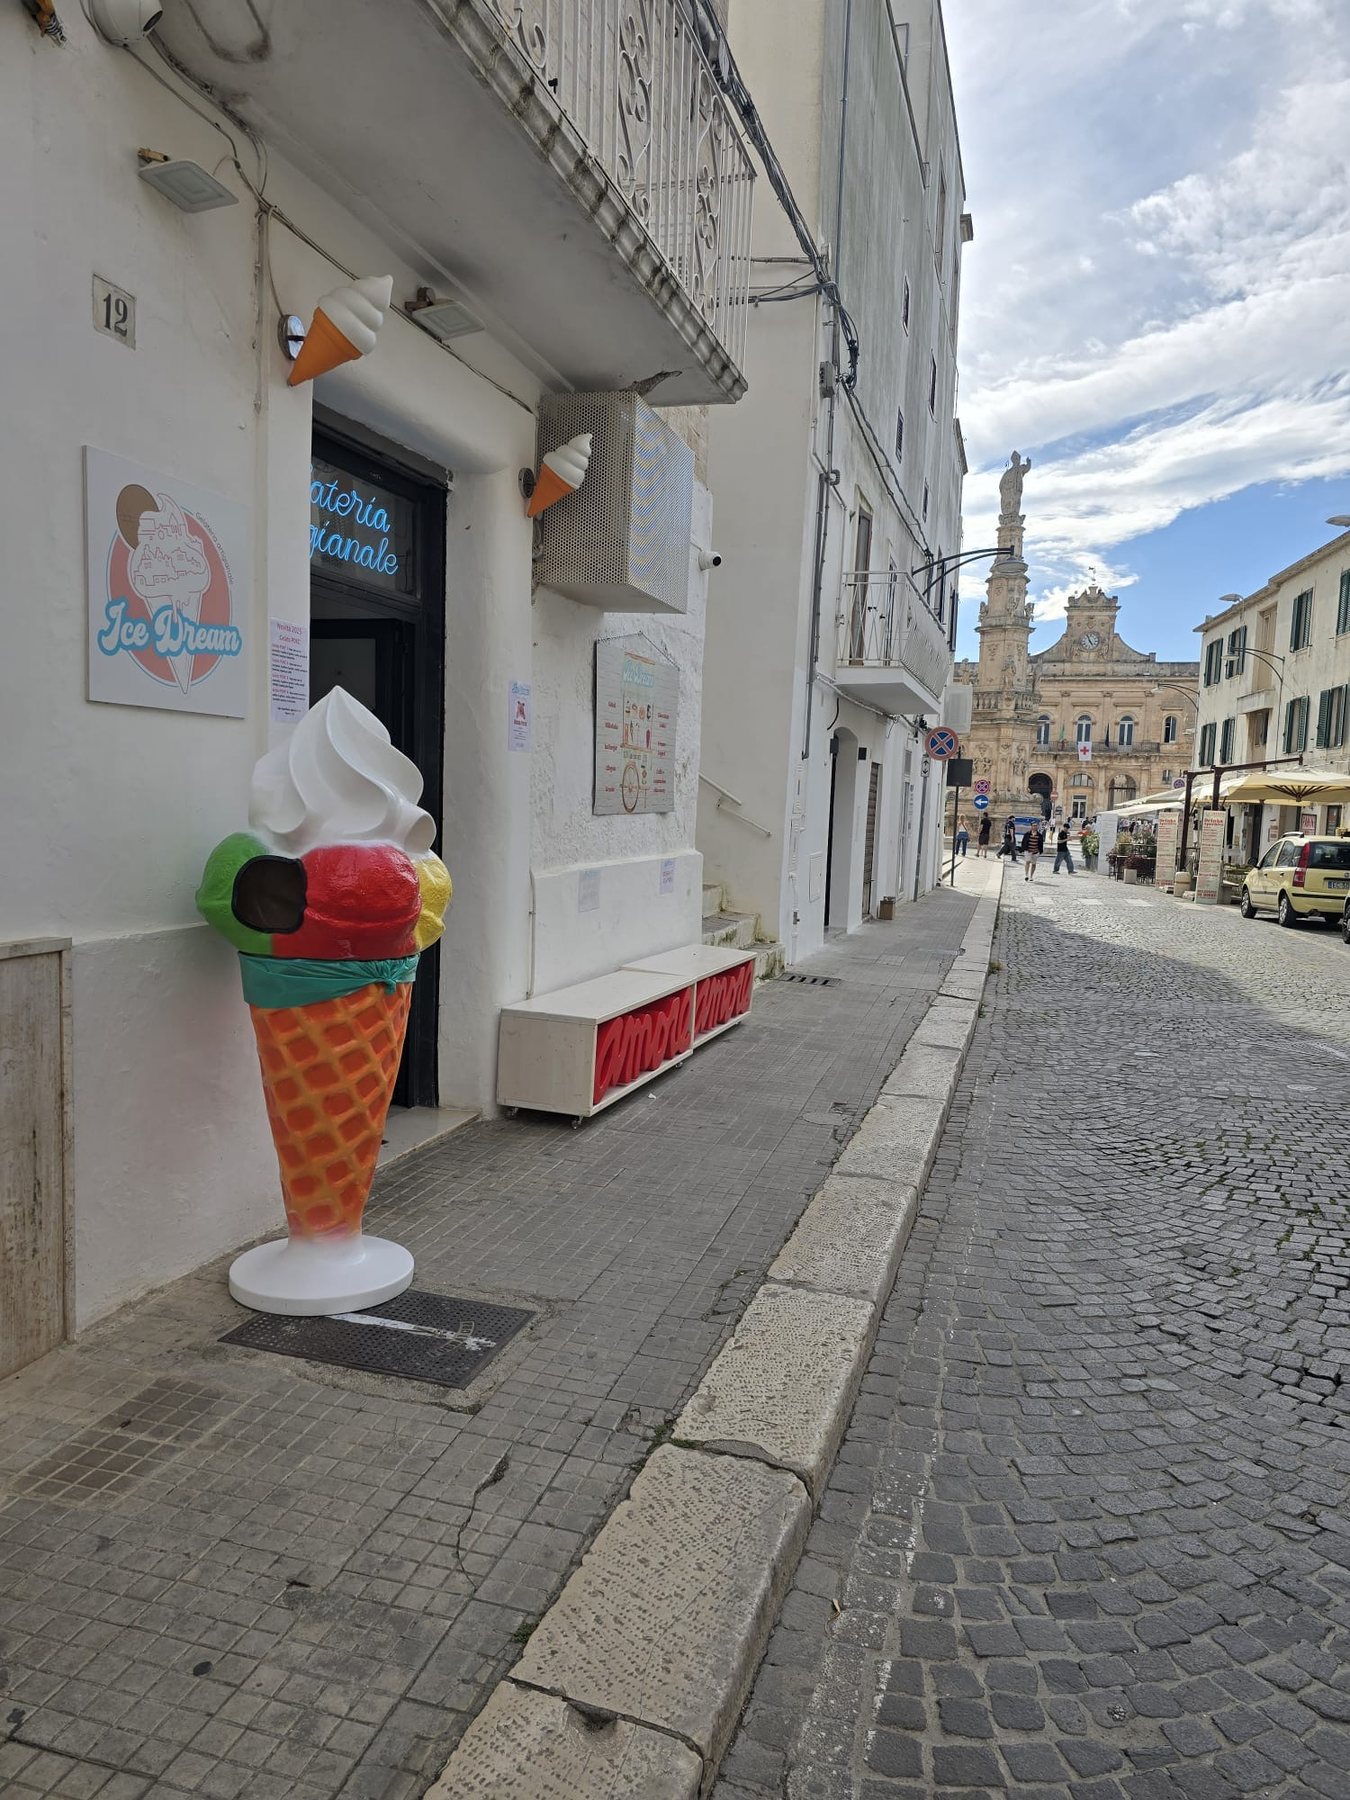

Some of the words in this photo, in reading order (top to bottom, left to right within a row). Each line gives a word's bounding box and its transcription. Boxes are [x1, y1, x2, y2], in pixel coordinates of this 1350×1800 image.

[102, 291, 128, 336] 12
[195, 511, 217, 543] Gelateria
[310, 478, 391, 534] ateria
[100, 600, 150, 653] Ice
[153, 604, 240, 657] Dream
